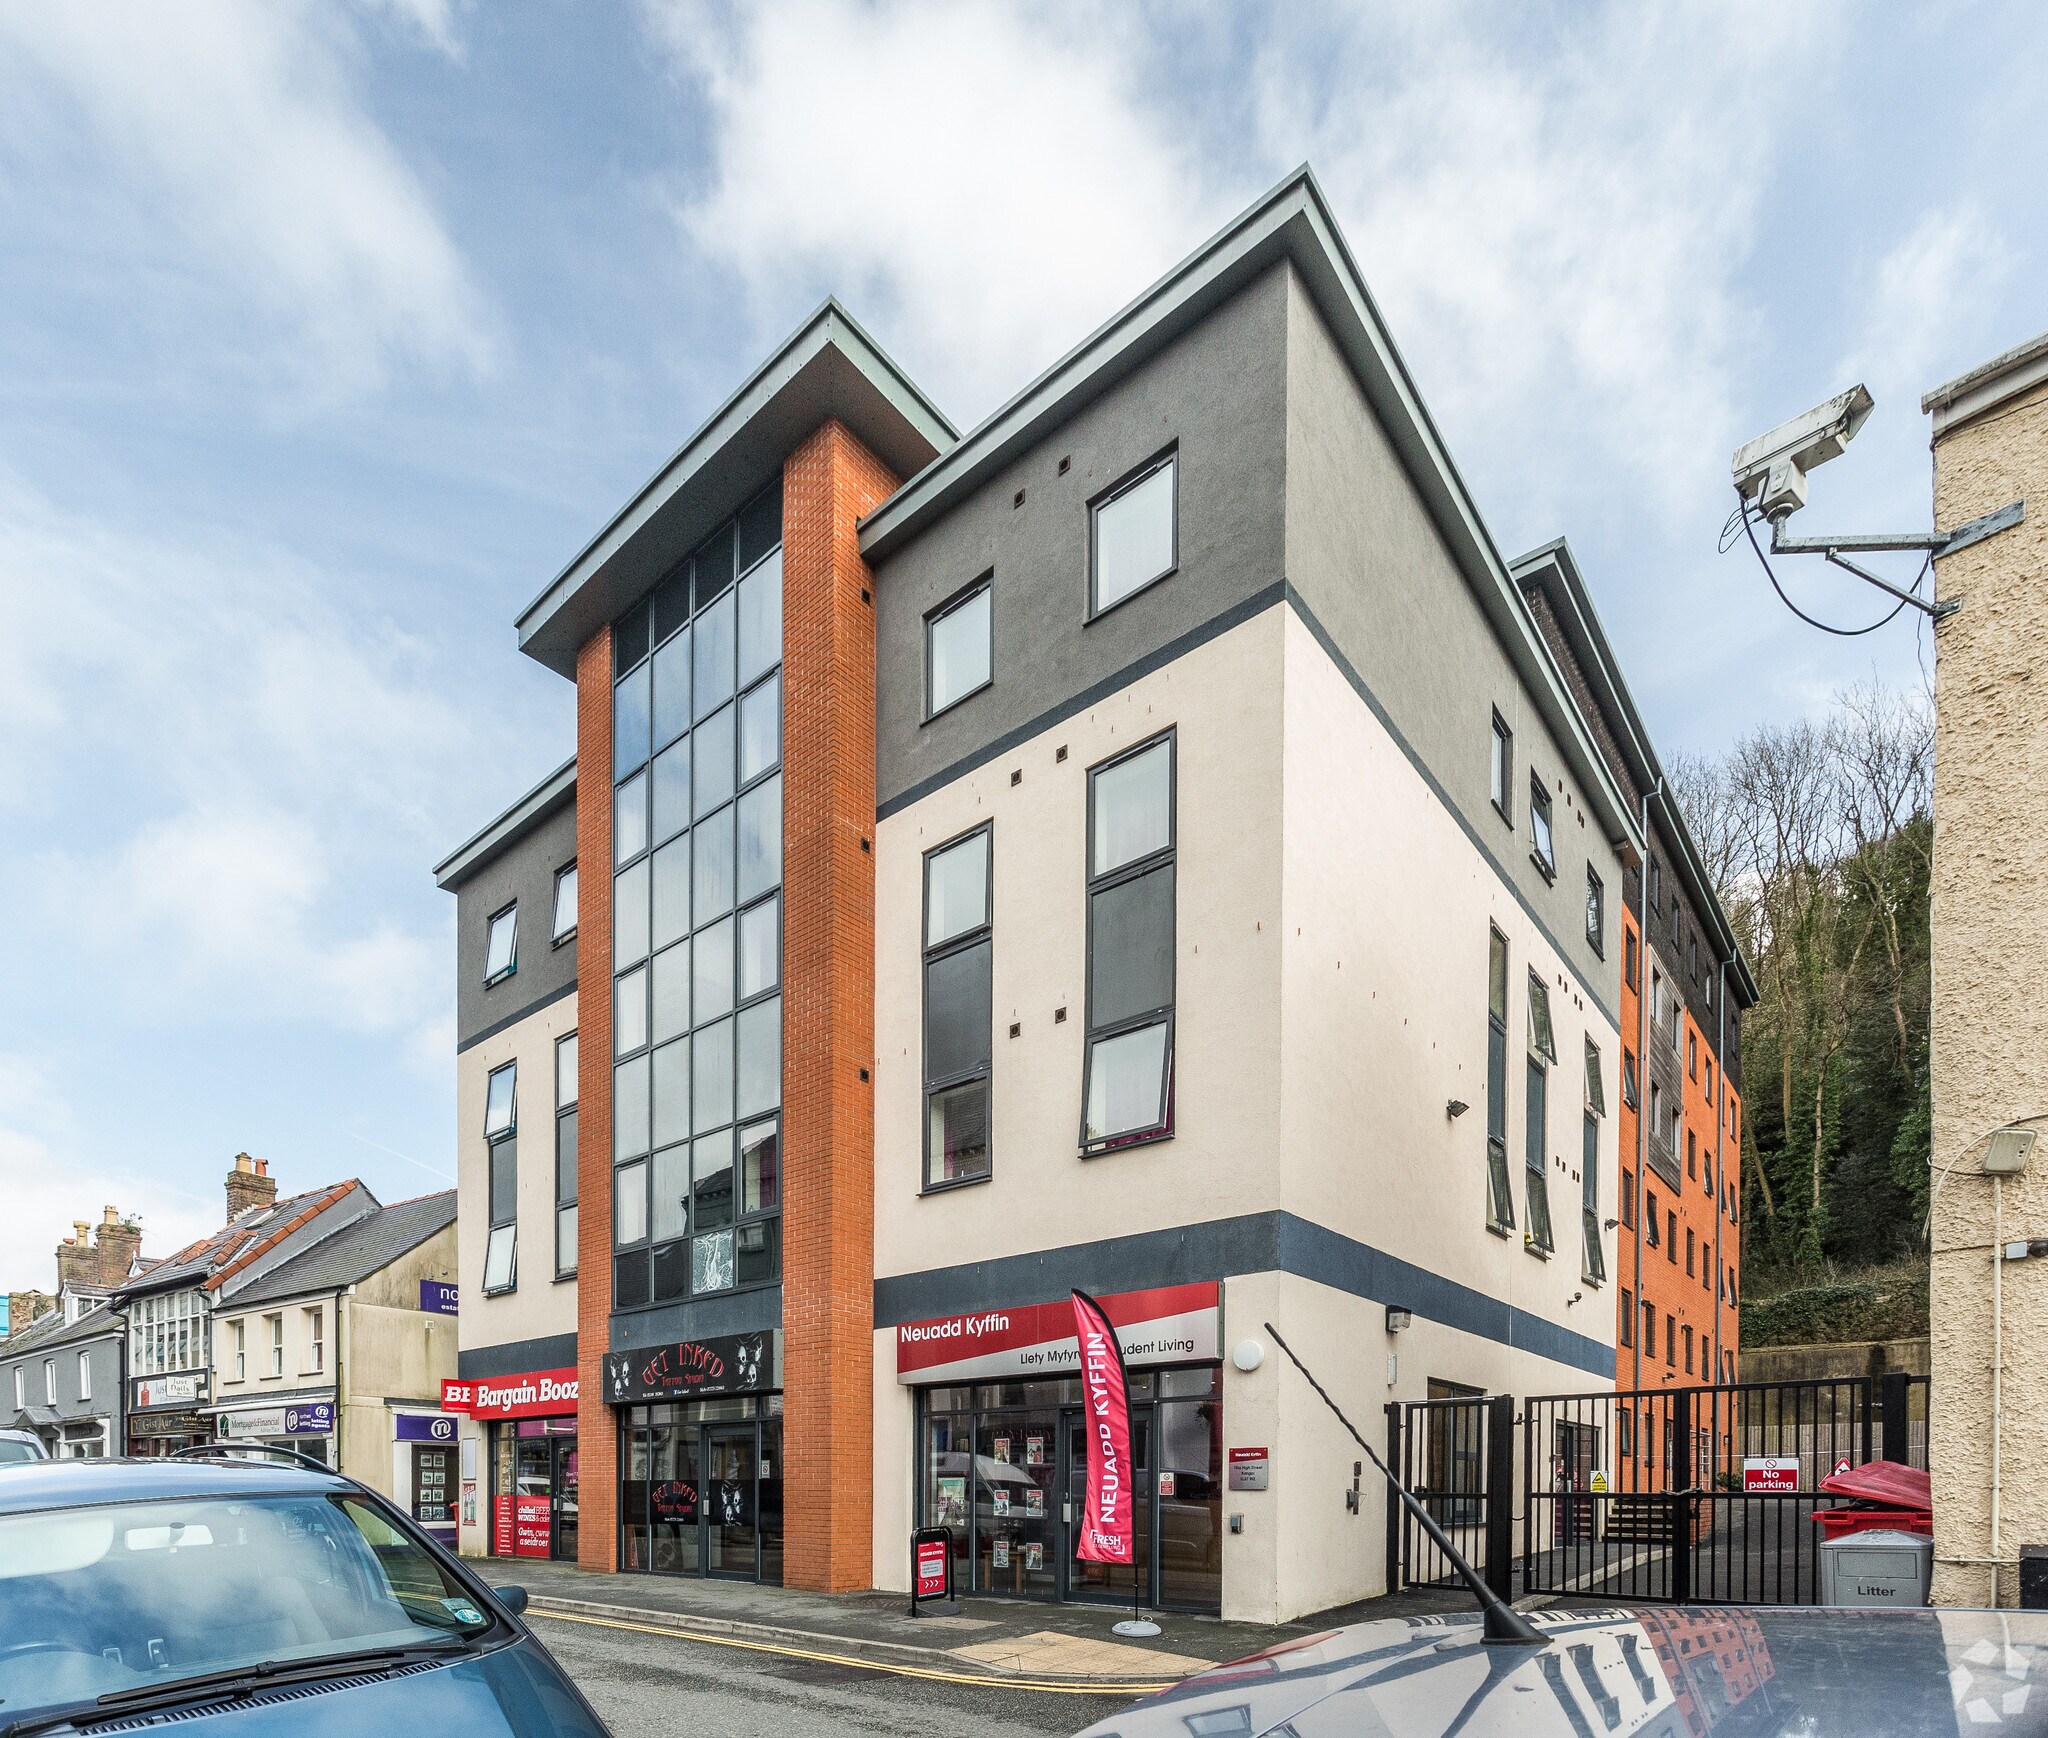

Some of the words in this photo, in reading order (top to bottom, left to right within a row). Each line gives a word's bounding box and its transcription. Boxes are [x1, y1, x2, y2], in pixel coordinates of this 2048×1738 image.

[901, 1319, 962, 1343] Neuadd
[965, 1313, 1010, 1338] Kyffin
[1020, 1350, 1045, 1365] Llety
[1047, 1348, 1081, 1364] Myfyr
[1121, 1340, 1155, 1356] udent
[1158, 1337, 1195, 1352] Living
[642, 1349, 669, 1386] GET
[679, 1343, 724, 1378] INKED
[1087, 1333, 1108, 1416] KYFFIN
[155, 1381, 168, 1395] Jus
[476, 1379, 537, 1412] Bargain
[142, 1418, 158, 1431] Gist
[1099, 1423, 1118, 1523] NEUADD
[1762, 1470, 1780, 1479] No
[1749, 1480, 1794, 1491] parking
[518, 1506, 536, 1514] chilled
[1093, 1534, 1121, 1546] FRESH
[1857, 1586, 1896, 1597] Litter
